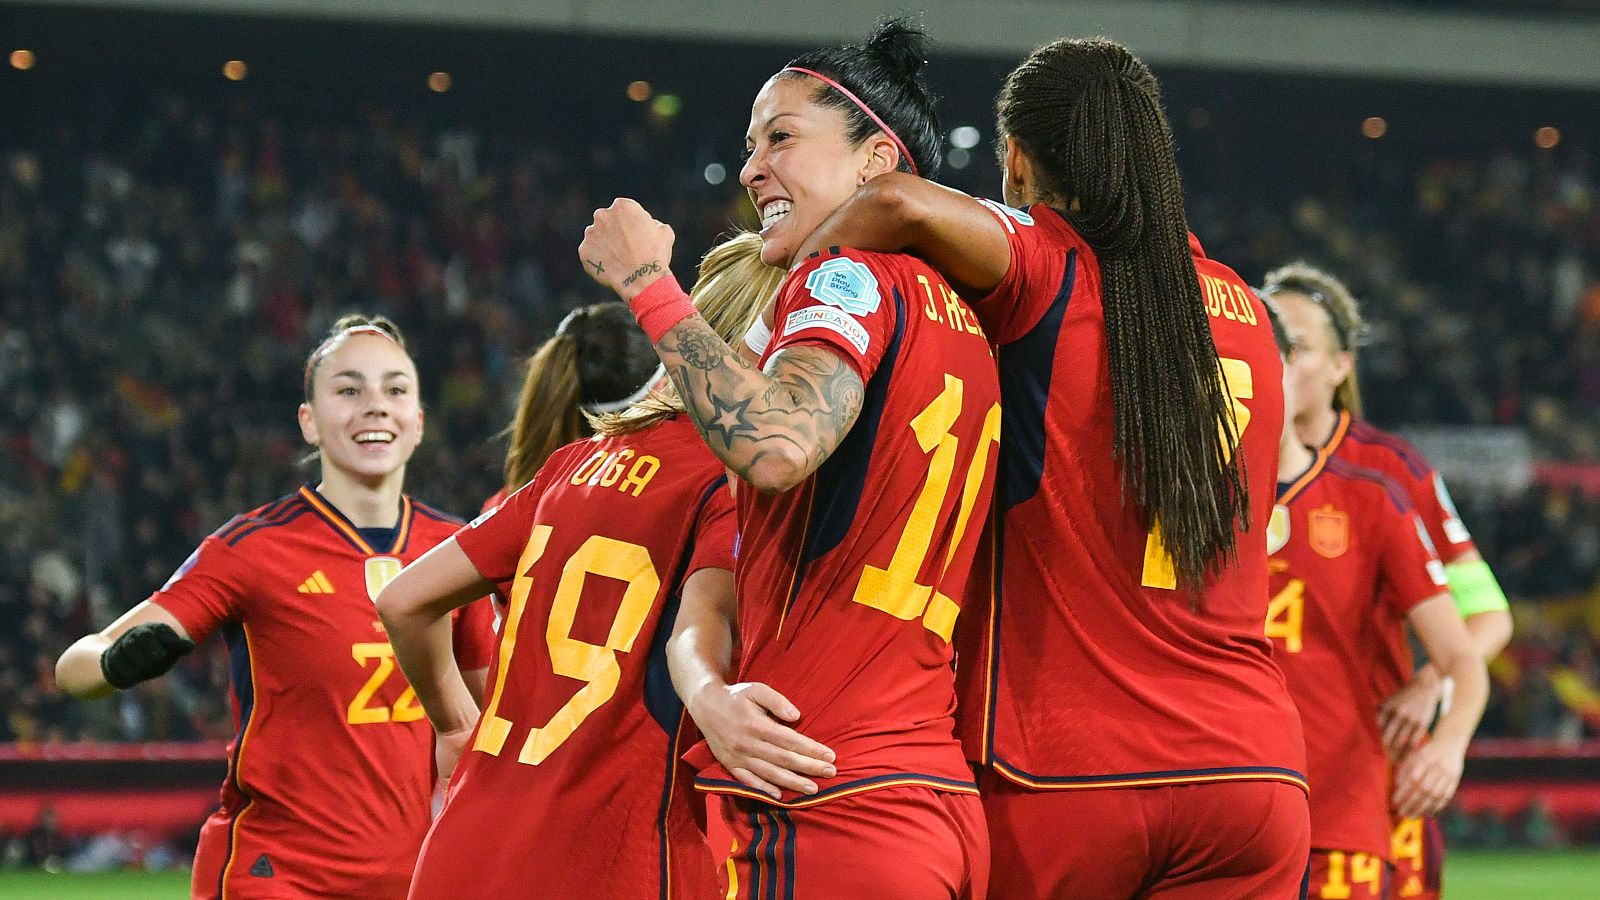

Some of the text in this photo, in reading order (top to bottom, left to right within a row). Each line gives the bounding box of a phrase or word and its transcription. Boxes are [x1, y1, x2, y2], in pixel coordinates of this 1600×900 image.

[623, 260, 661, 287] Karma
[834, 271, 847, 280] We
[1199, 273, 1258, 326] UELO
[788, 312, 867, 346] FOUNDATION
[571, 449, 661, 498] OLGA
[472, 524, 661, 765] 19
[1320, 851, 1382, 899] 14
